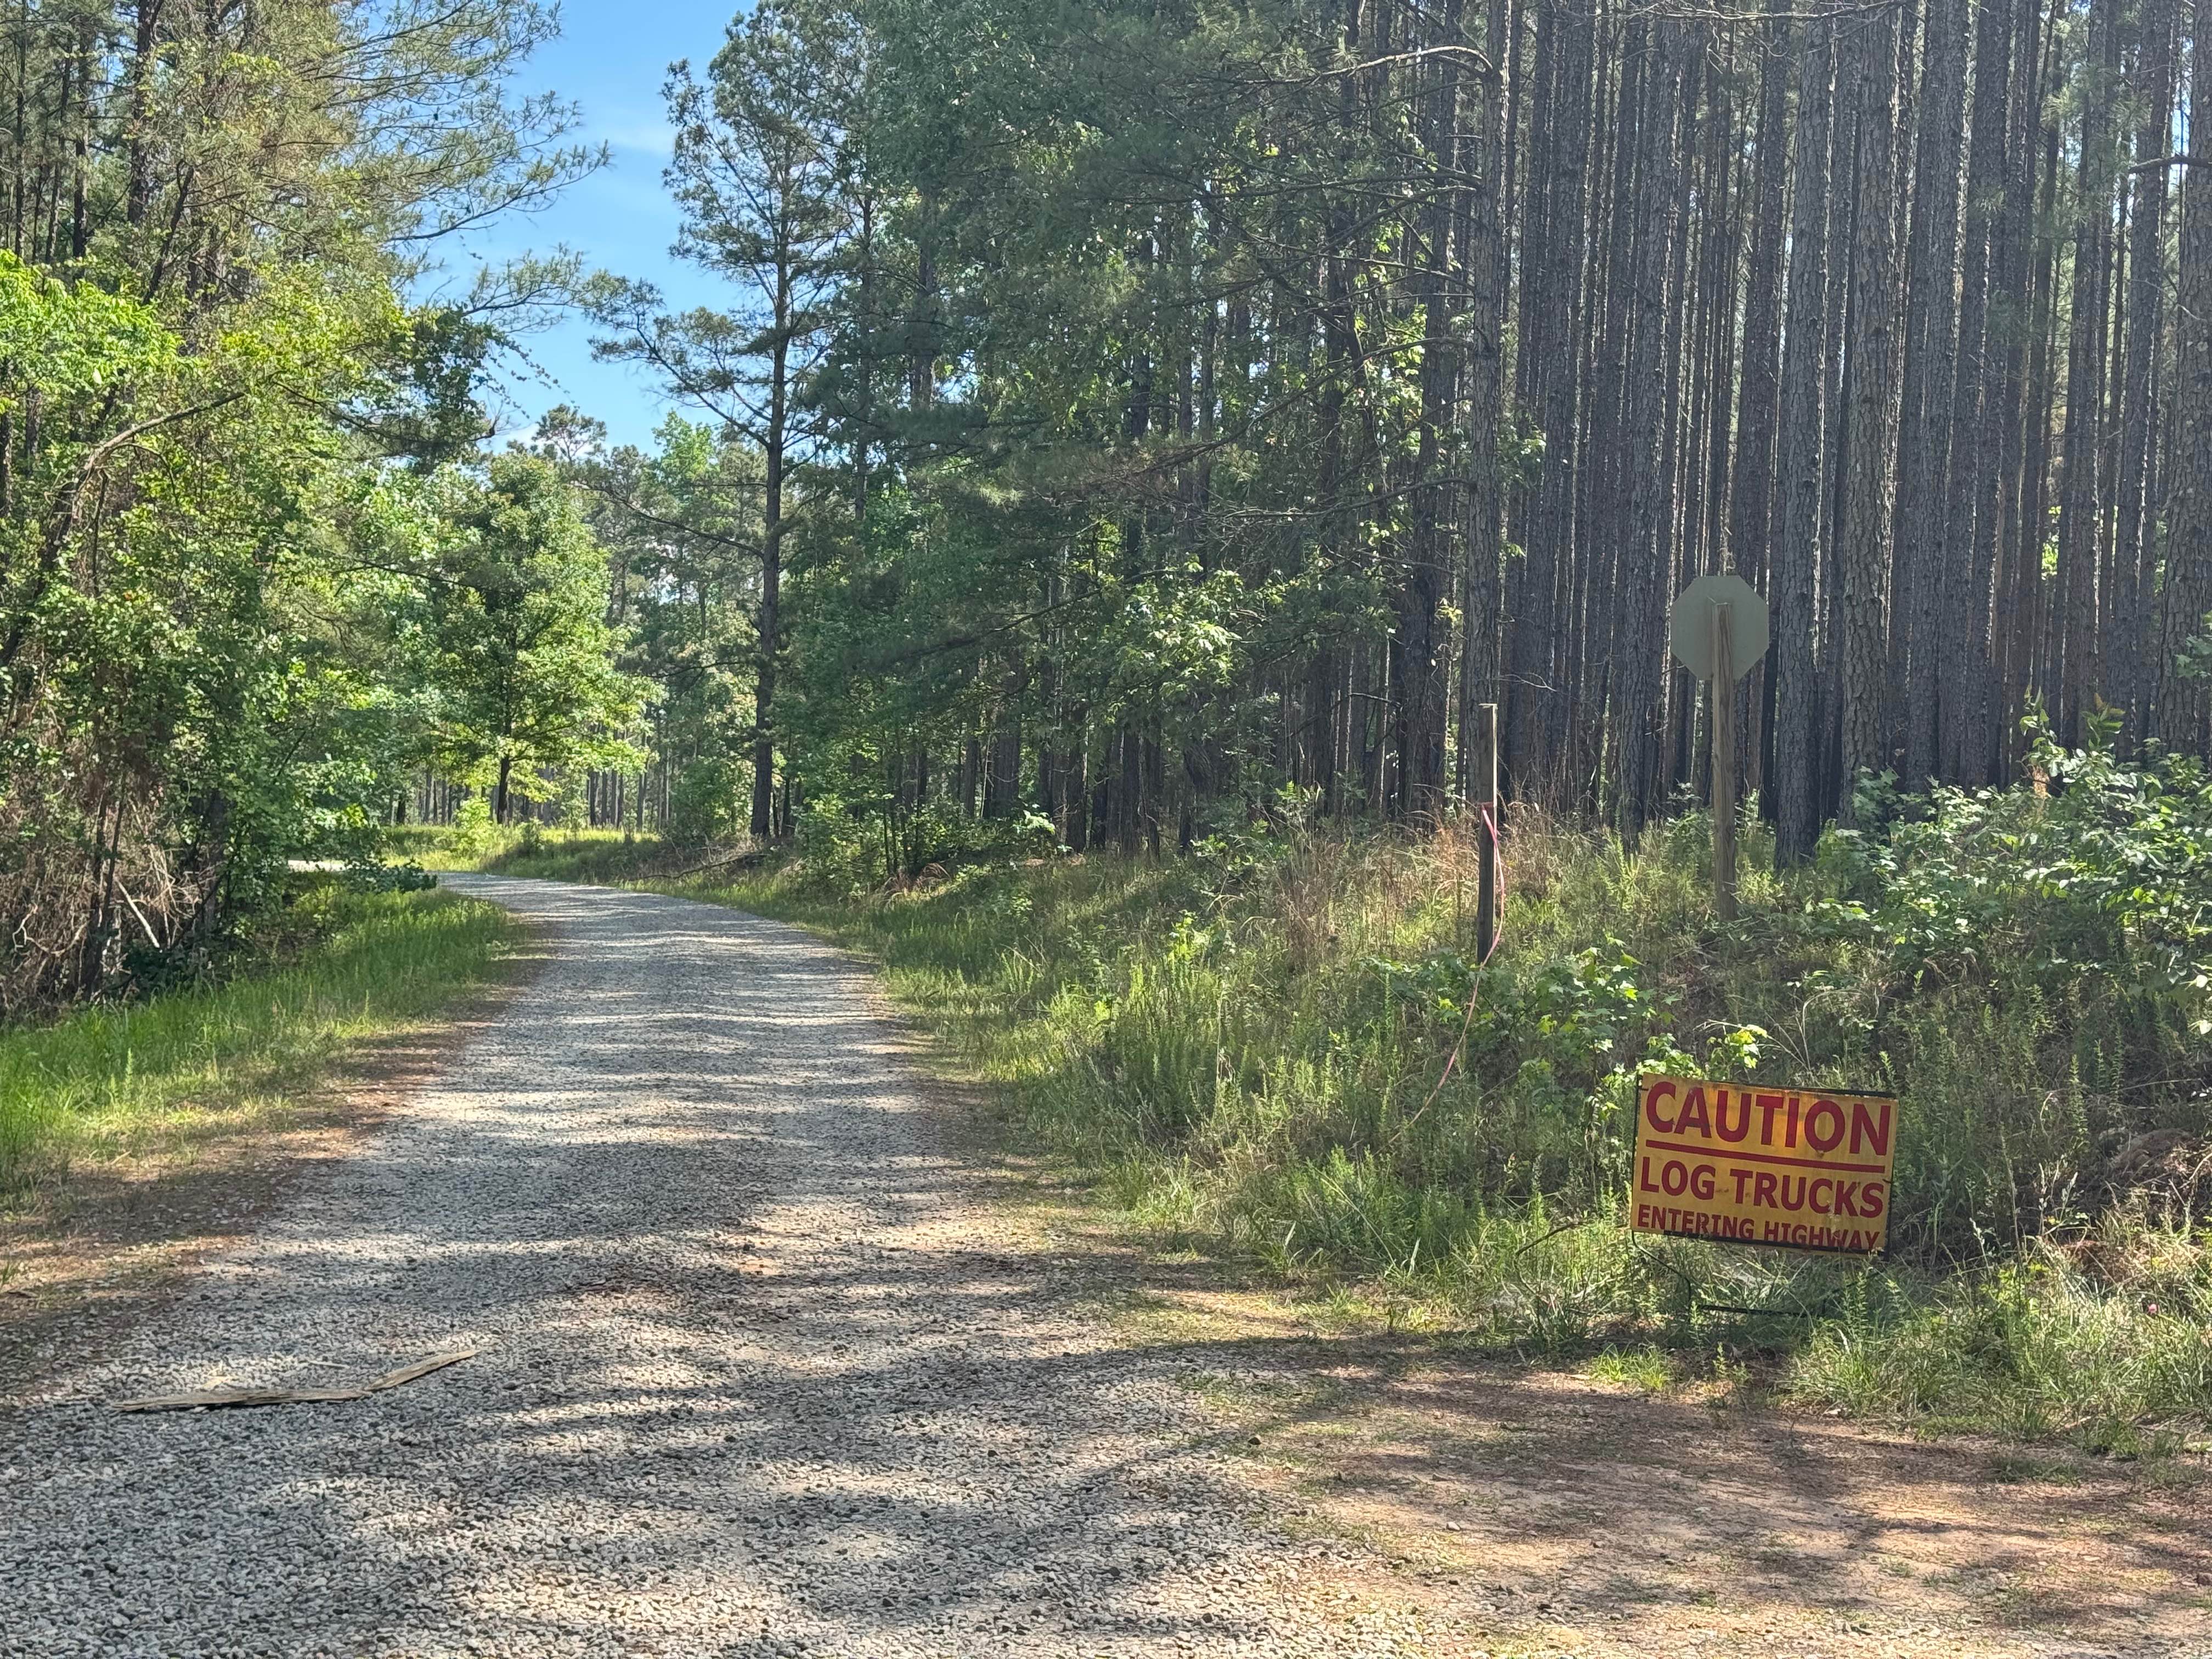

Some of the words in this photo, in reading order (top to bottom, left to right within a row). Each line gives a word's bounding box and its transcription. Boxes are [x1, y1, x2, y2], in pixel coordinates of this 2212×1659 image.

[1646, 1081, 1891, 1156] CAUTION
[1640, 1156, 1716, 1200] LOG
[1730, 1169, 1885, 1218] TRUCKS
[1638, 1204, 1754, 1239] ENTERING
[1764, 1221, 1880, 1250] HIGHWAY
